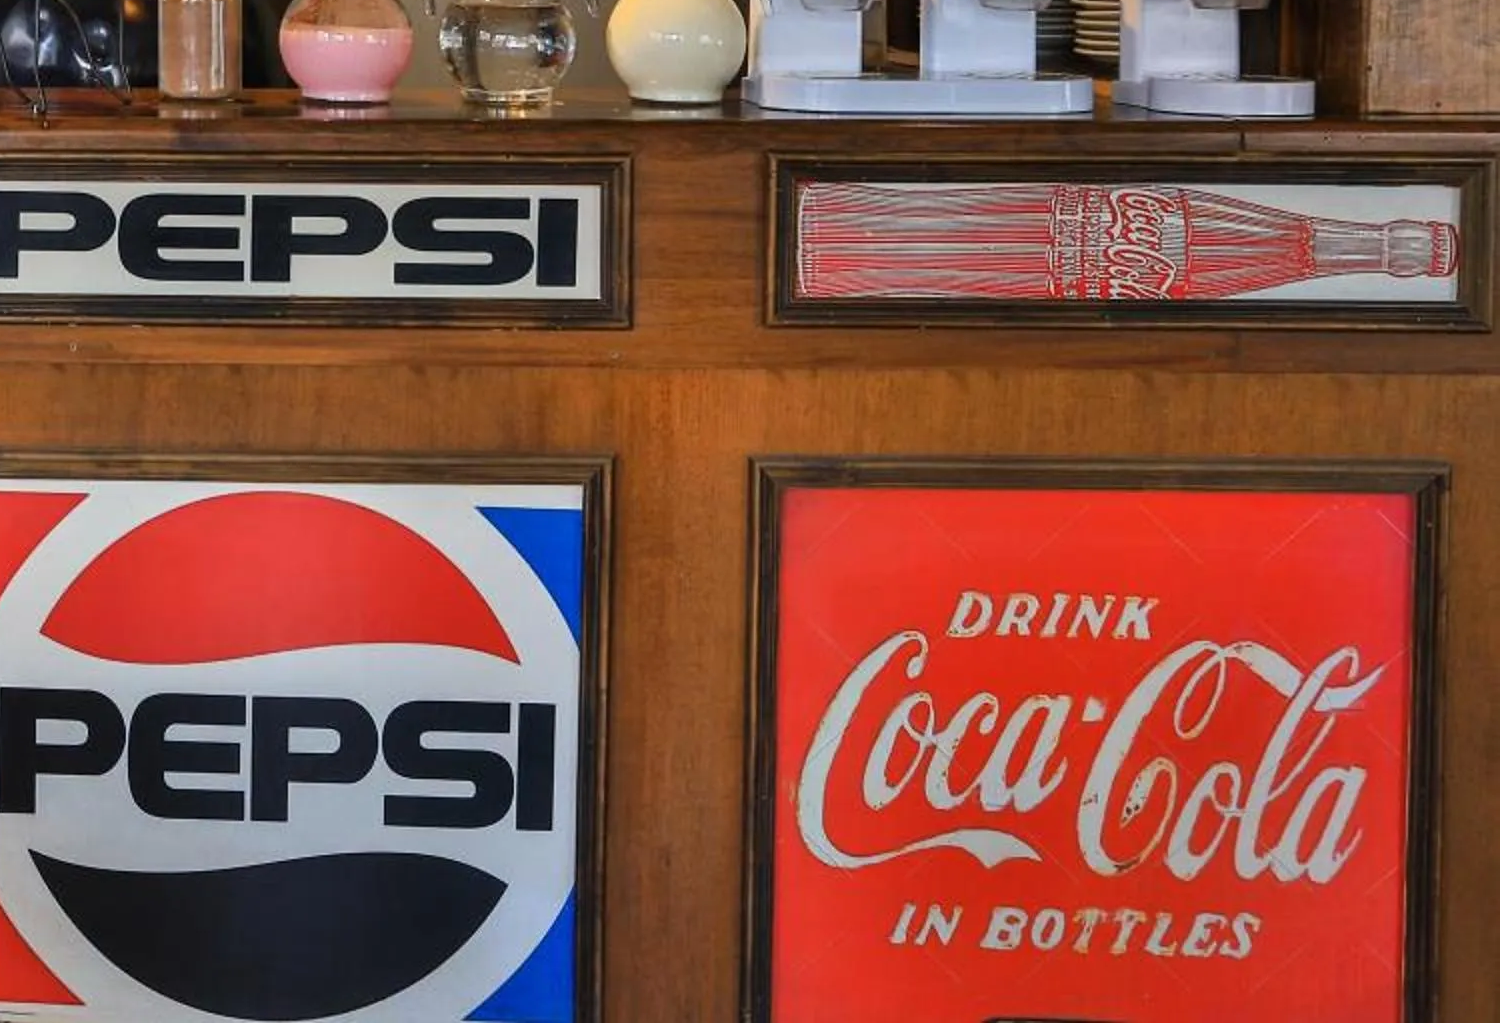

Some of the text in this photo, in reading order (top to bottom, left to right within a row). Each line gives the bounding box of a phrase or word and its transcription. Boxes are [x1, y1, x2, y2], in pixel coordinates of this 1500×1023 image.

[945, 590, 1160, 641] DRINK
[797, 630, 1385, 884] Coca-Cola
[889, 903, 1262, 959] IN BOTTLES
